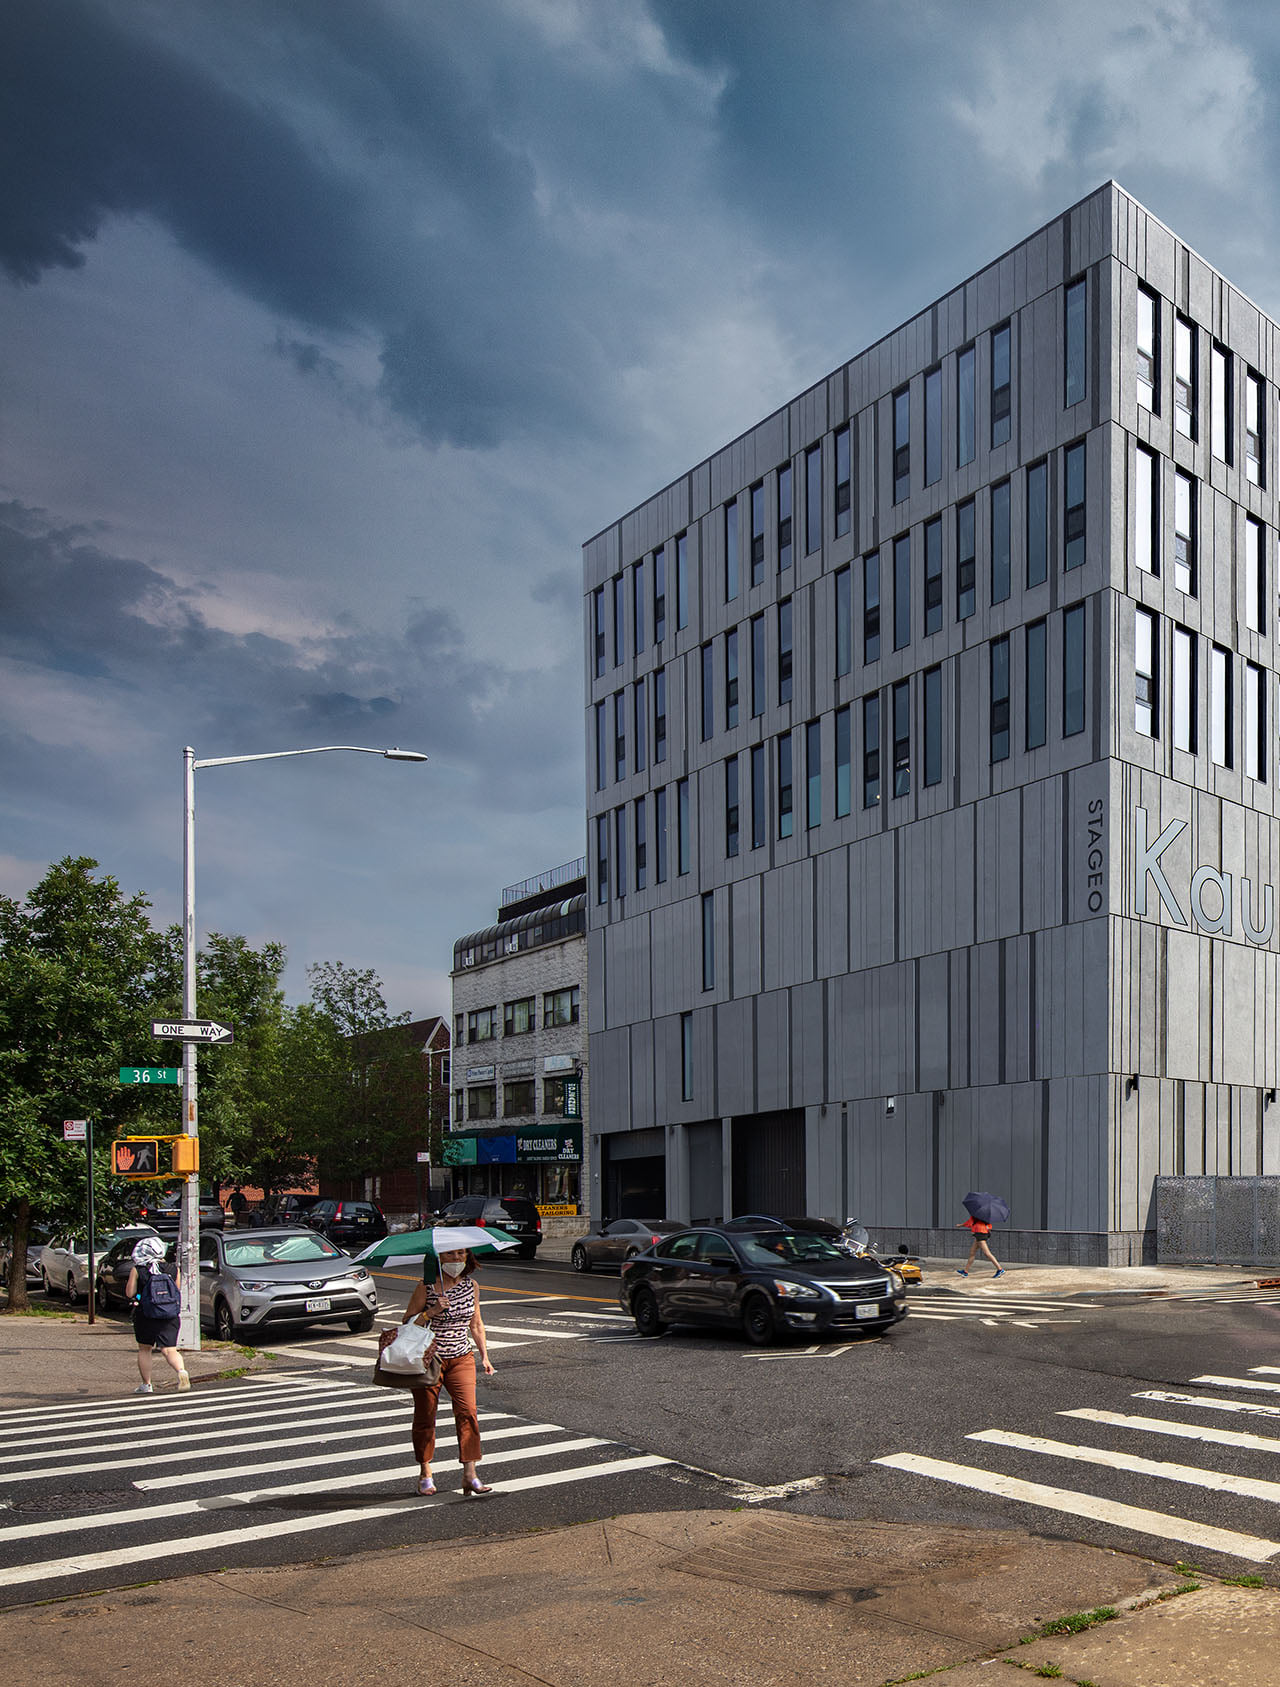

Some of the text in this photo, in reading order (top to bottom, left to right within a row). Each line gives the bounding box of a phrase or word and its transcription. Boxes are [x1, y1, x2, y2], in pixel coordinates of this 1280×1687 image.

[161, 1025, 223, 1037] ONE WAY
[133, 1069, 167, 1083] 36 St
